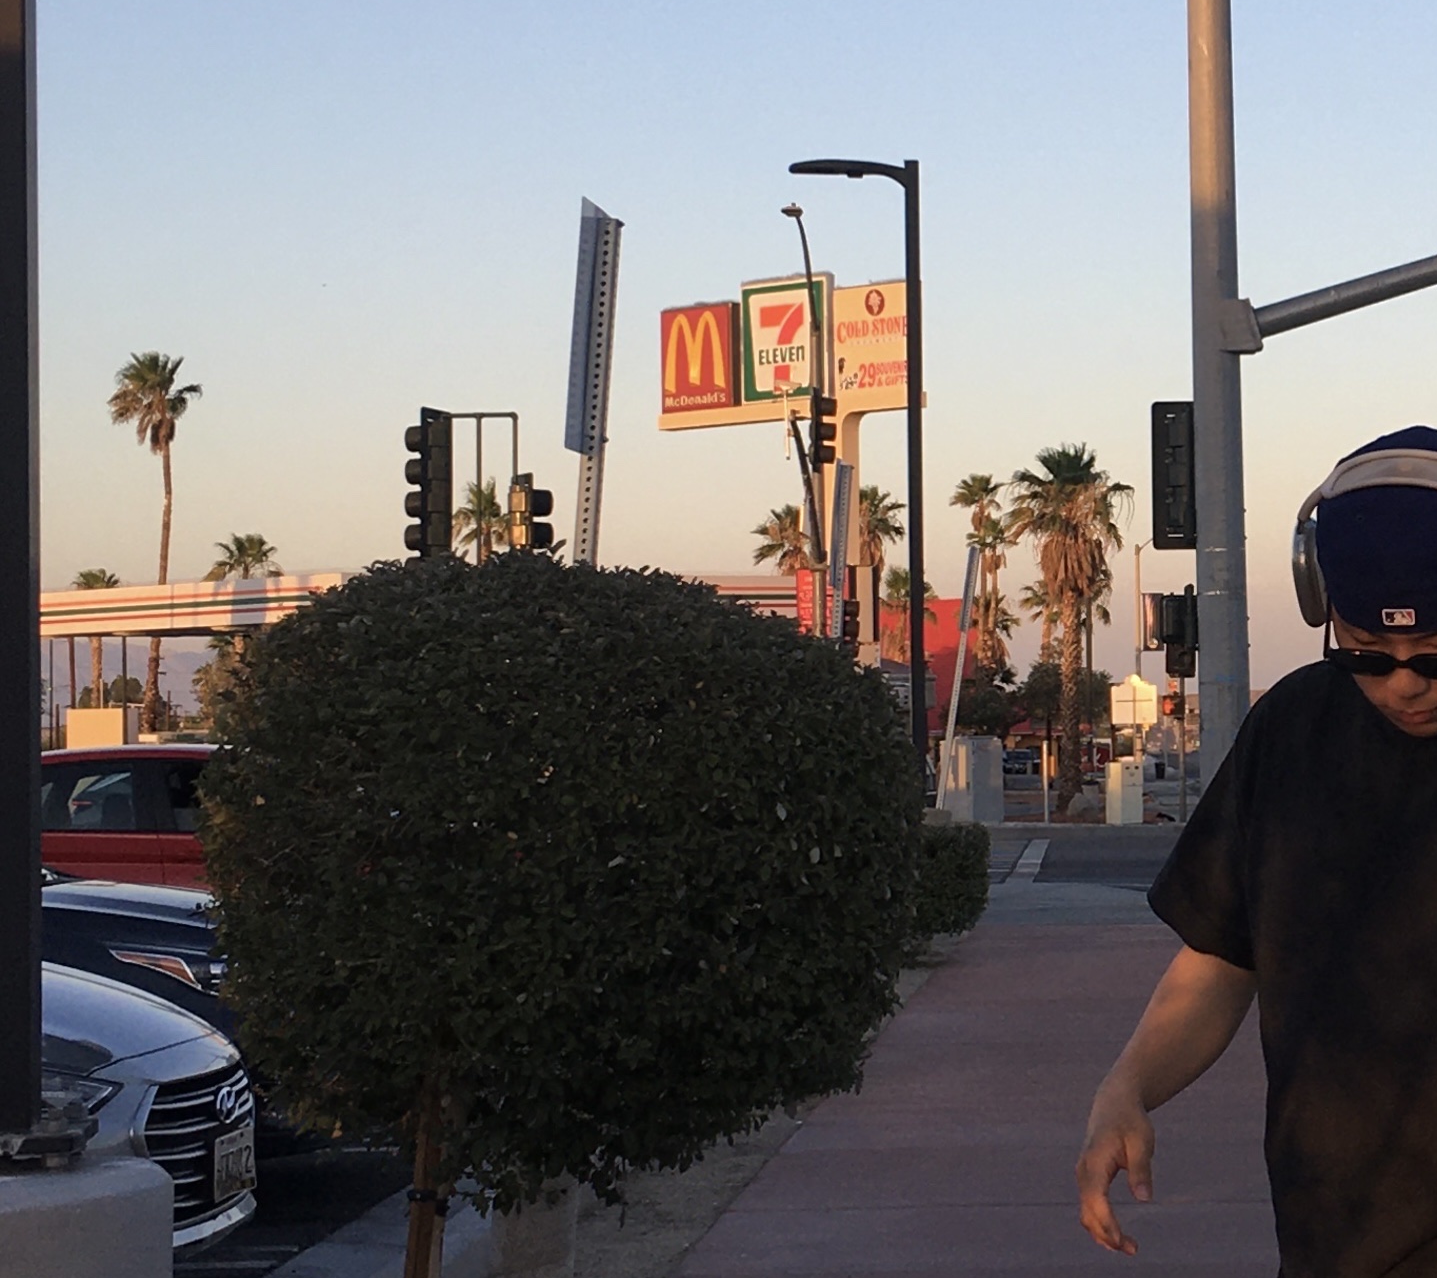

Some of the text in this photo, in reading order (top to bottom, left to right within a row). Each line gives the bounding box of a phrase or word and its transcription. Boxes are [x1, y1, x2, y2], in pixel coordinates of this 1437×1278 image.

[836, 320, 870, 344] COLD
[857, 362, 876, 389] 29
[664, 392, 726, 408] McDonald's
